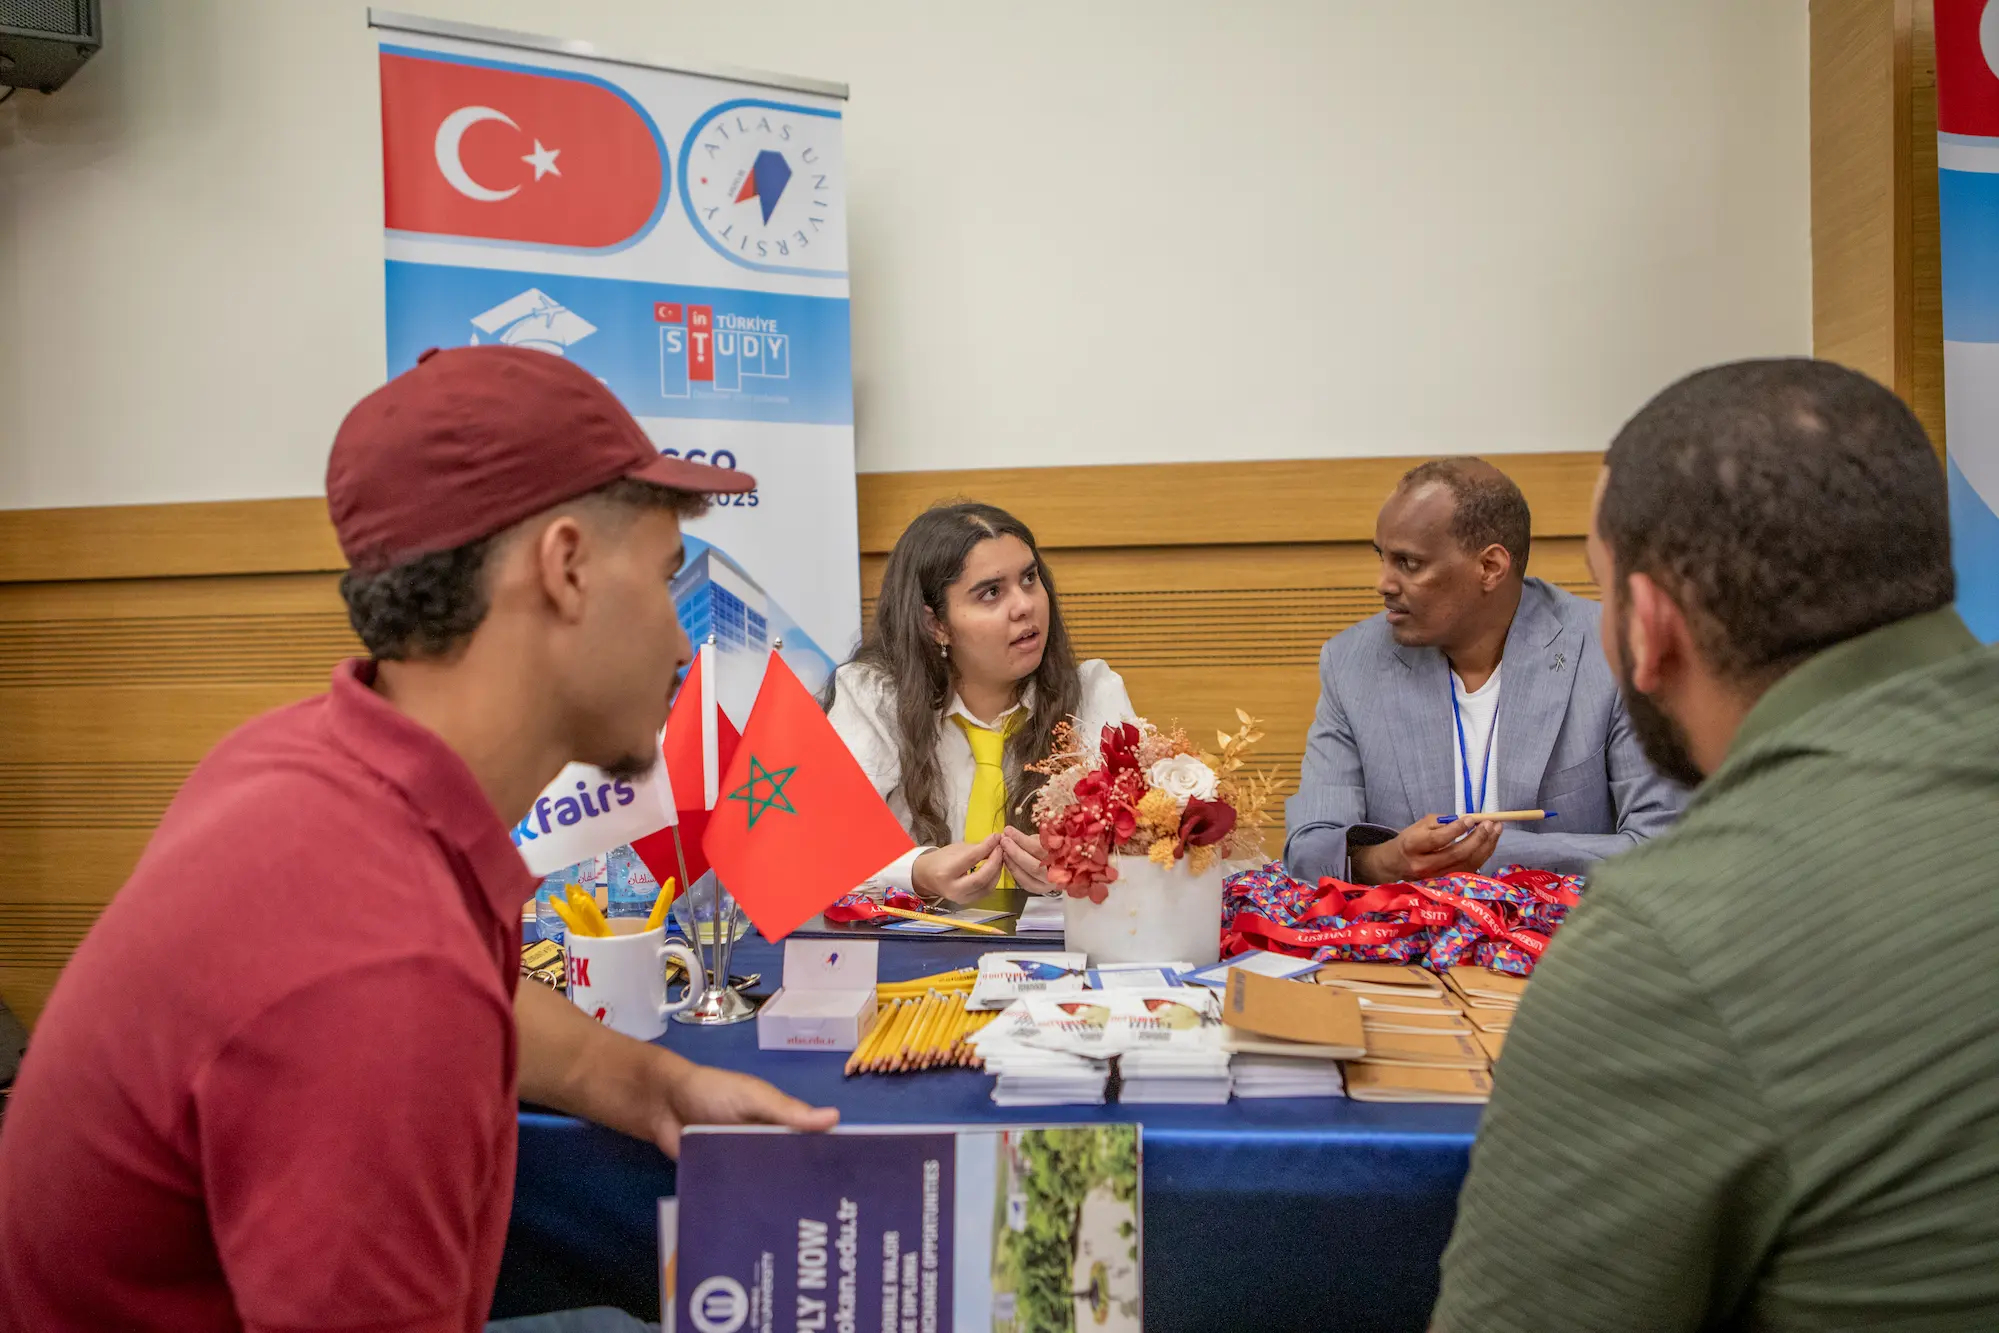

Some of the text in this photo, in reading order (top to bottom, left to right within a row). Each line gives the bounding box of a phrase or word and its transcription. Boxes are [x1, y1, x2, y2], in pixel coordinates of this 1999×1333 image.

[704, 117, 829, 257] ATLAS UNIVERSITY
[716, 313, 777, 333] TÜRKİYE
[1296, 930, 1352, 942] UNIVERSITY
[798, 1218, 828, 1289] NOW
